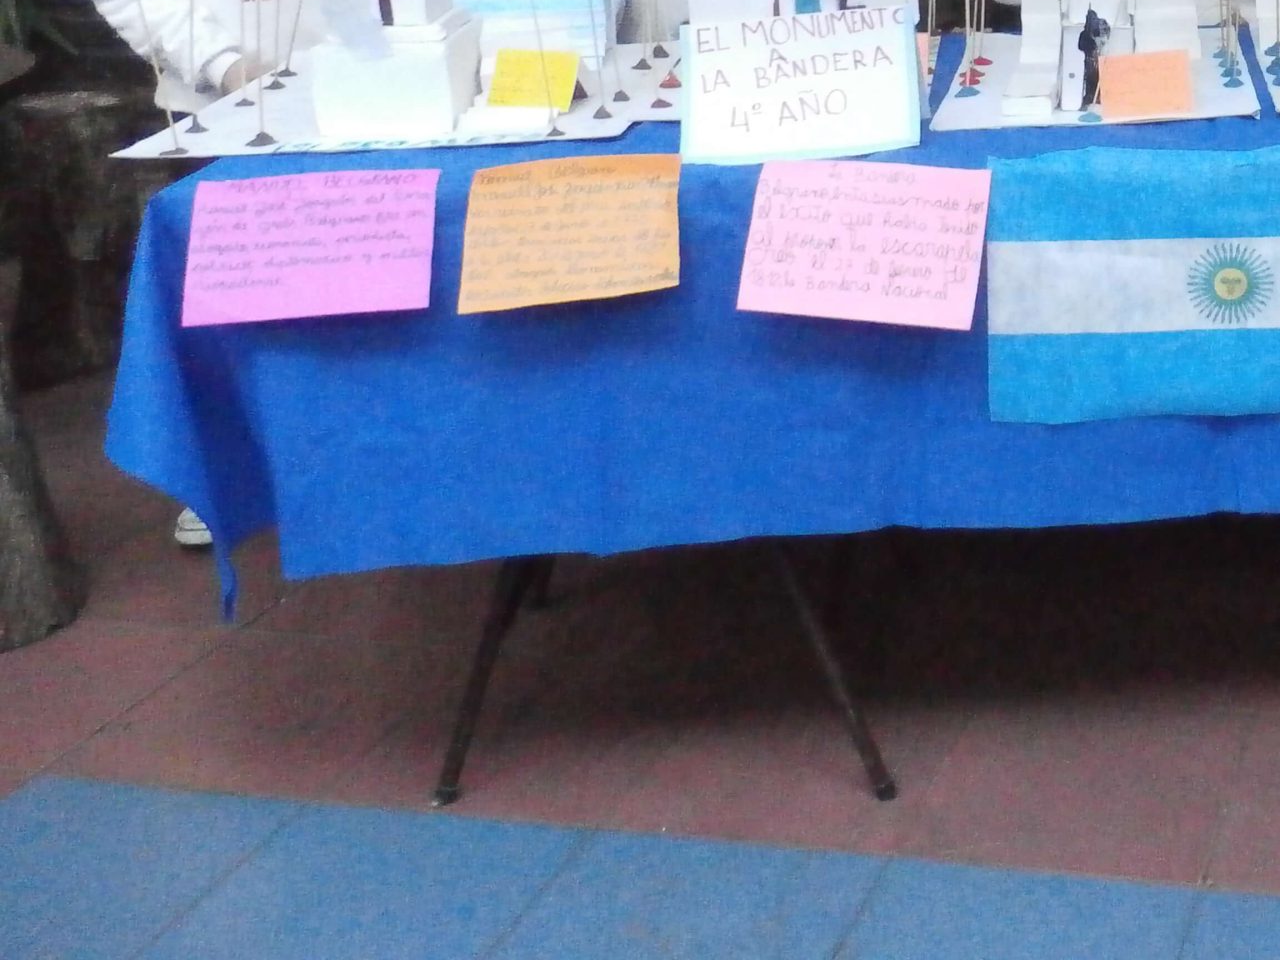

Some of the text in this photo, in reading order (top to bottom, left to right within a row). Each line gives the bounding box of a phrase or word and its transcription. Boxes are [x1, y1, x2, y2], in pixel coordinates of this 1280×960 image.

[696, 7, 906, 54] EL MONUMENTO
[700, 45, 894, 94] LA BANDERA
[768, 47, 788, 69] A
[777, 88, 848, 127] AÑO
